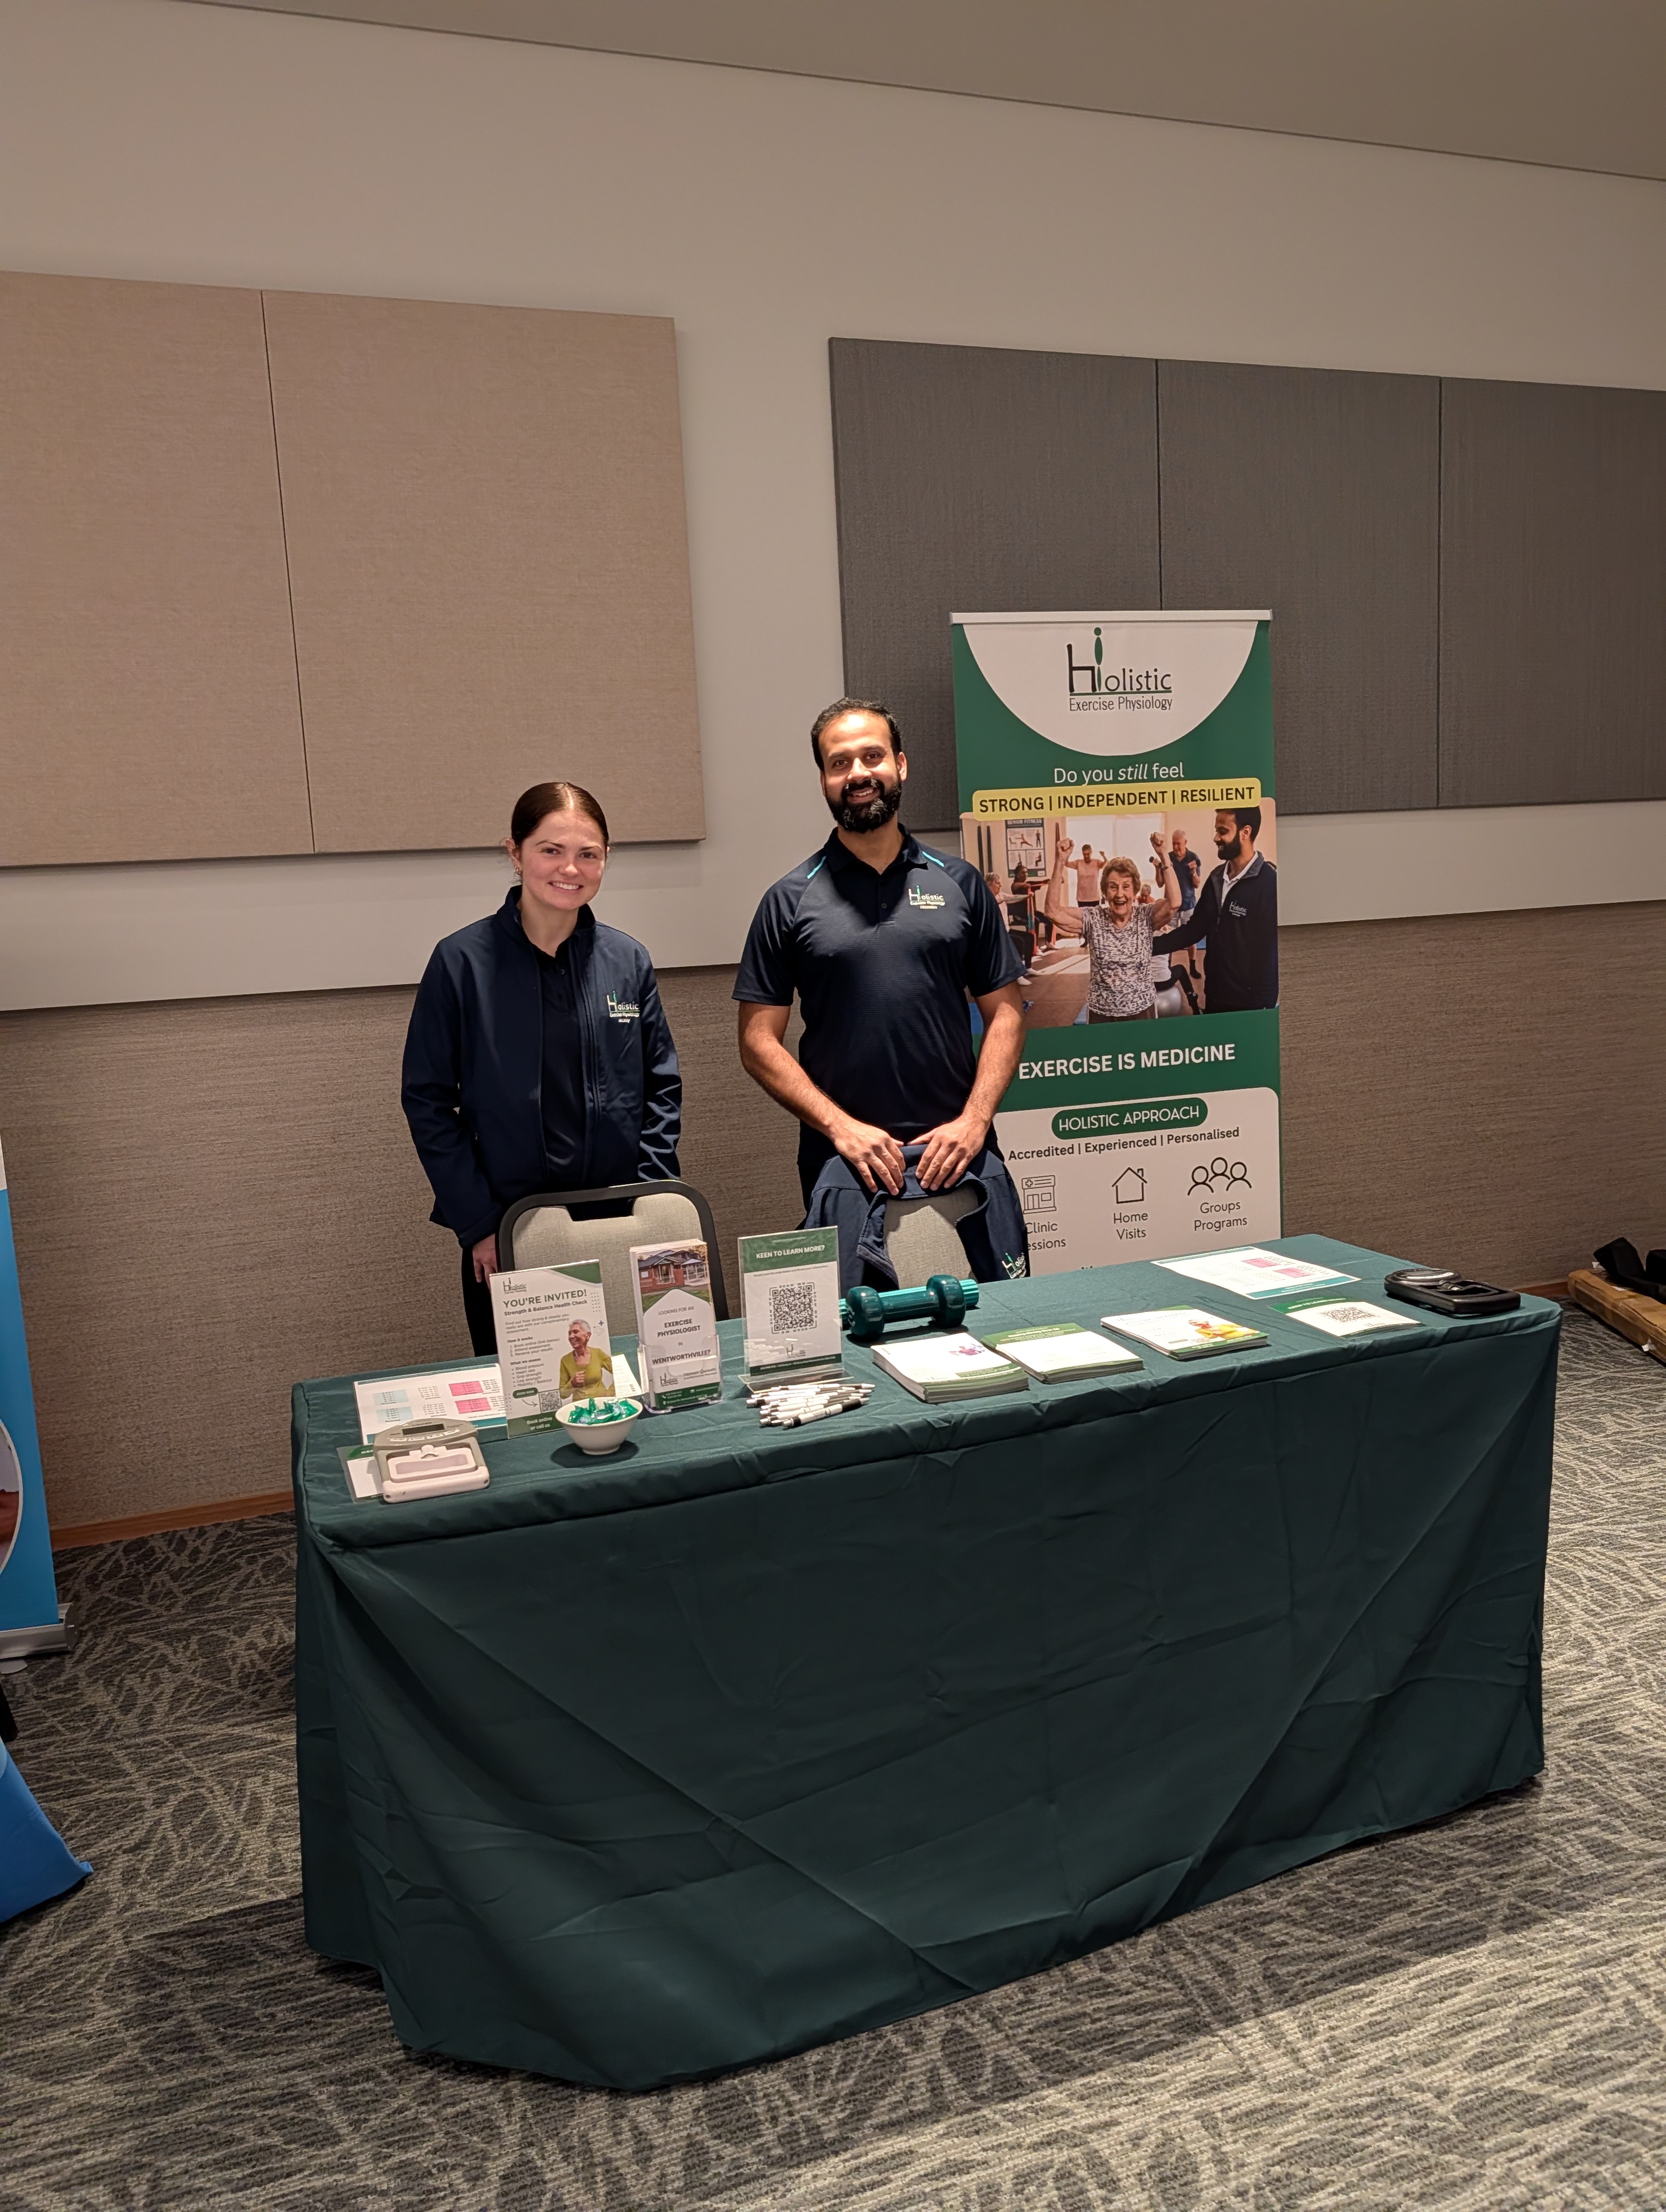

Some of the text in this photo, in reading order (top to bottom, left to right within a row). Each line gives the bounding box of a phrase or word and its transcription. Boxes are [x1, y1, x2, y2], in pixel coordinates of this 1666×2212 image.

[1067, 627, 1172, 693] Holistic
[1069, 696, 1173, 712] Exercise Physiology
[1054, 762, 1184, 786] Do you still feel
[979, 796, 1044, 813] STRONG
[1057, 790, 1168, 809] INDEPENDENT
[1180, 787, 1254, 802] RESILIENT
[1018, 1044, 1235, 1079] EXERCISE IS MEDICINE
[1059, 1105, 1200, 1131] HOLISTIC APPROACH
[1008, 1144, 1074, 1161] Accredited
[1085, 1135, 1157, 1154] Experienced
[1167, 1127, 1240, 1144] Personalised
[1200, 1201, 1241, 1214] Groups
[1113, 1211, 1148, 1224] Home
[1194, 1217, 1247, 1232] Programs
[1025, 1221, 1058, 1234] Clinic
[1116, 1227, 1146, 1240] Visits
[1027, 1239, 1066, 1250] essions
[756, 1251, 773, 1259] KEEN
[804, 1245, 825, 1253] MORE?
[544, 1289, 587, 1302] INVITED!
[504, 1308, 527, 1316] Strength
[664, 1319, 693, 1328] EXERCISE
[657, 1325, 701, 1338] PHYSIOLOGIST
[652, 1349, 711, 1365] WENTWORTHVILLE?
